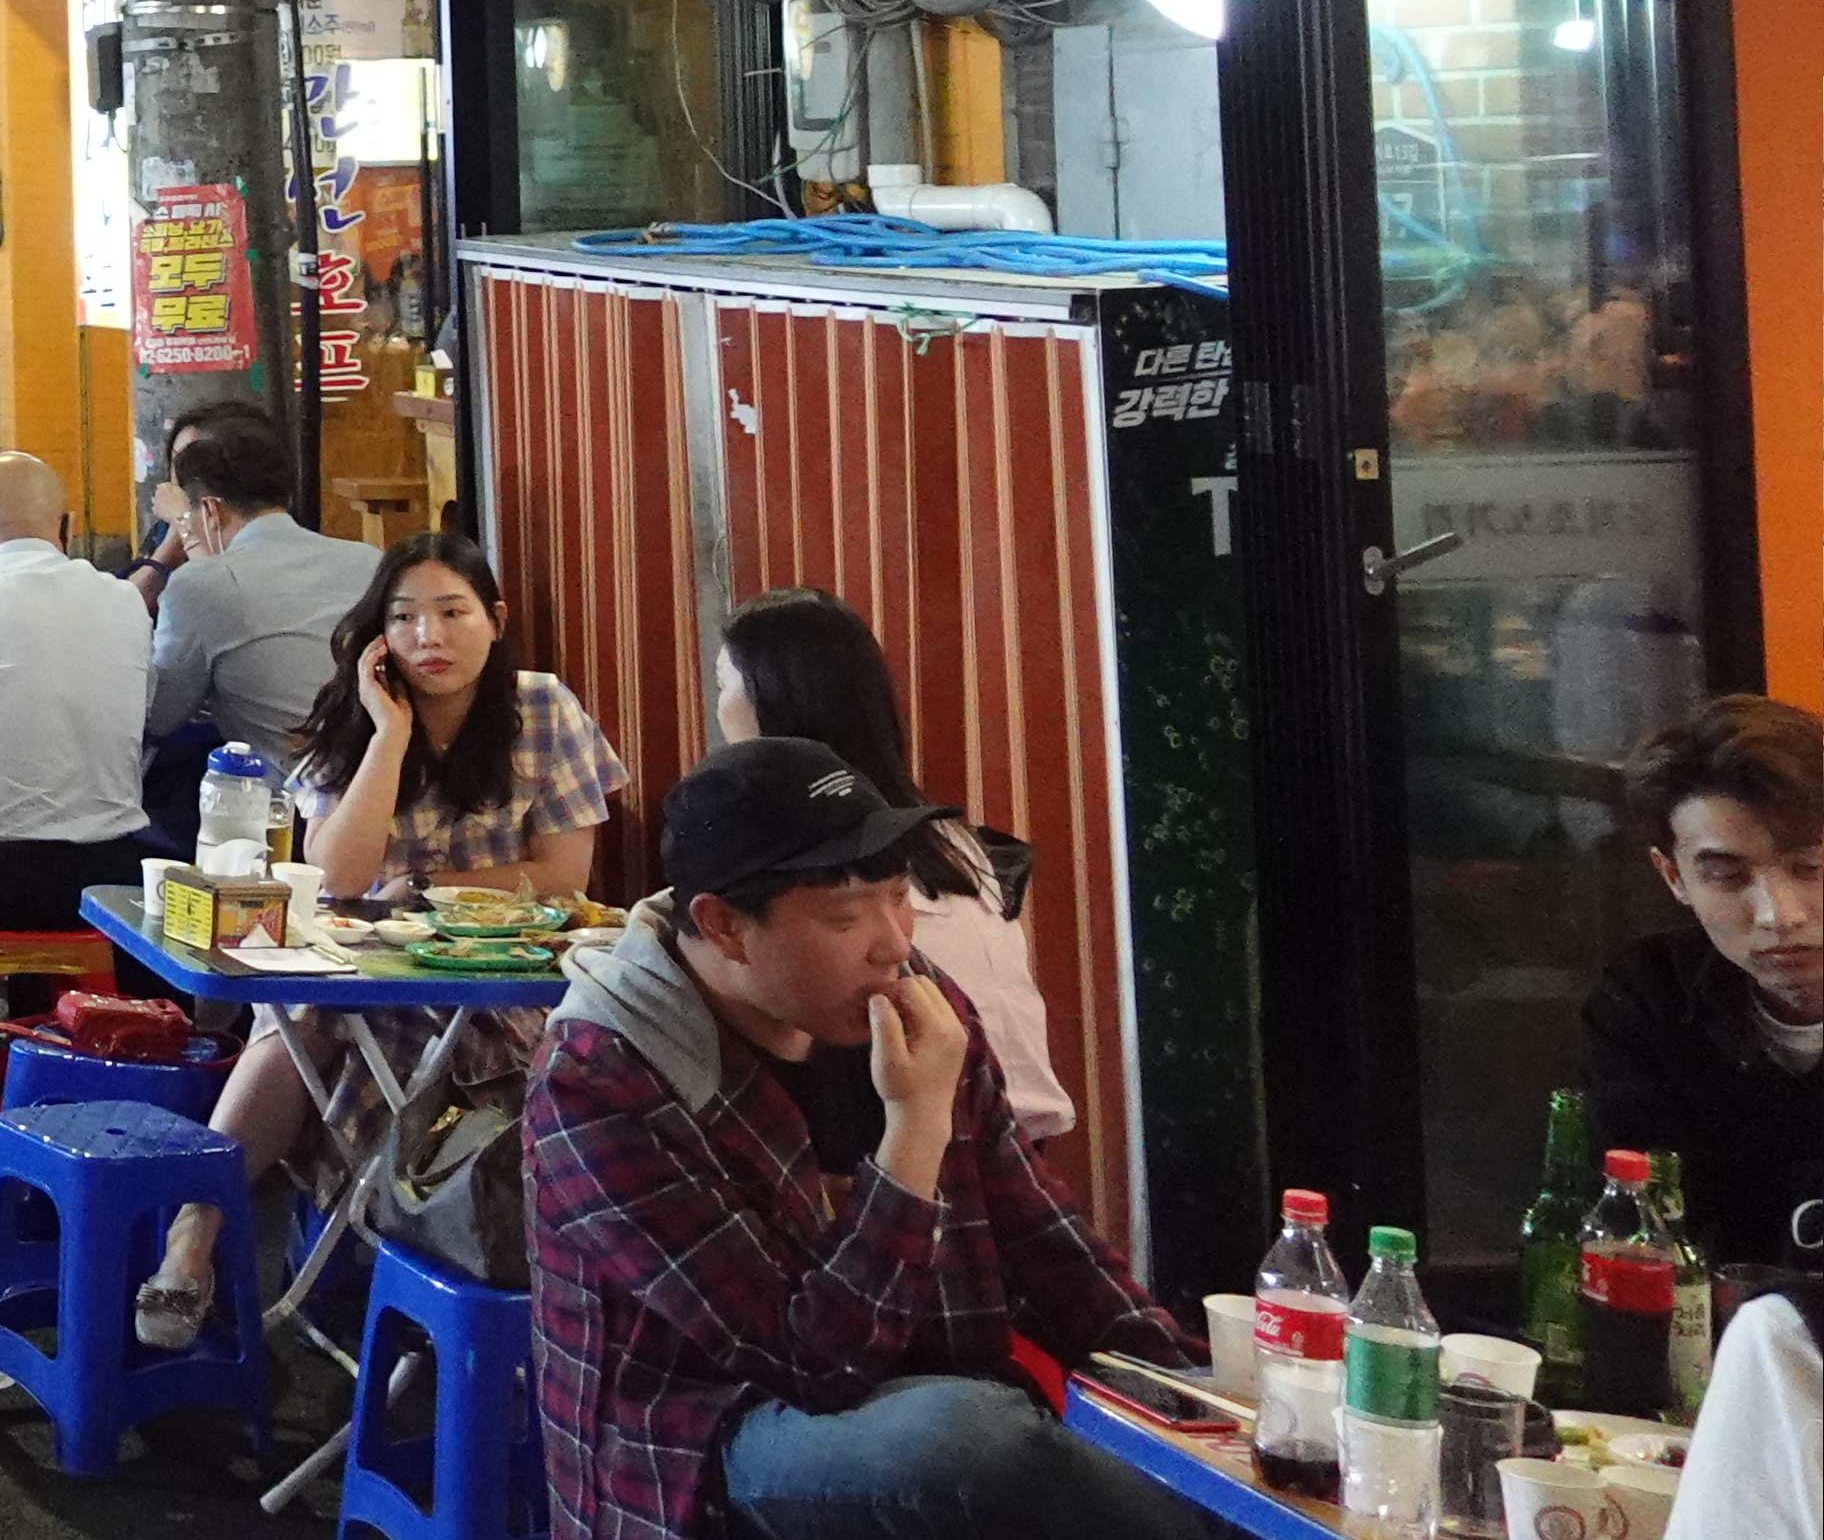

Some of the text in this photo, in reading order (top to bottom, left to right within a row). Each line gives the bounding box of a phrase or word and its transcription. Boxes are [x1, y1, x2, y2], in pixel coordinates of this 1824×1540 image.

[149, 251, 225, 292] 모두
[151, 294, 228, 334] 무료
[1134, 344, 1194, 377] 다른
[1112, 377, 1230, 429] 강력한
